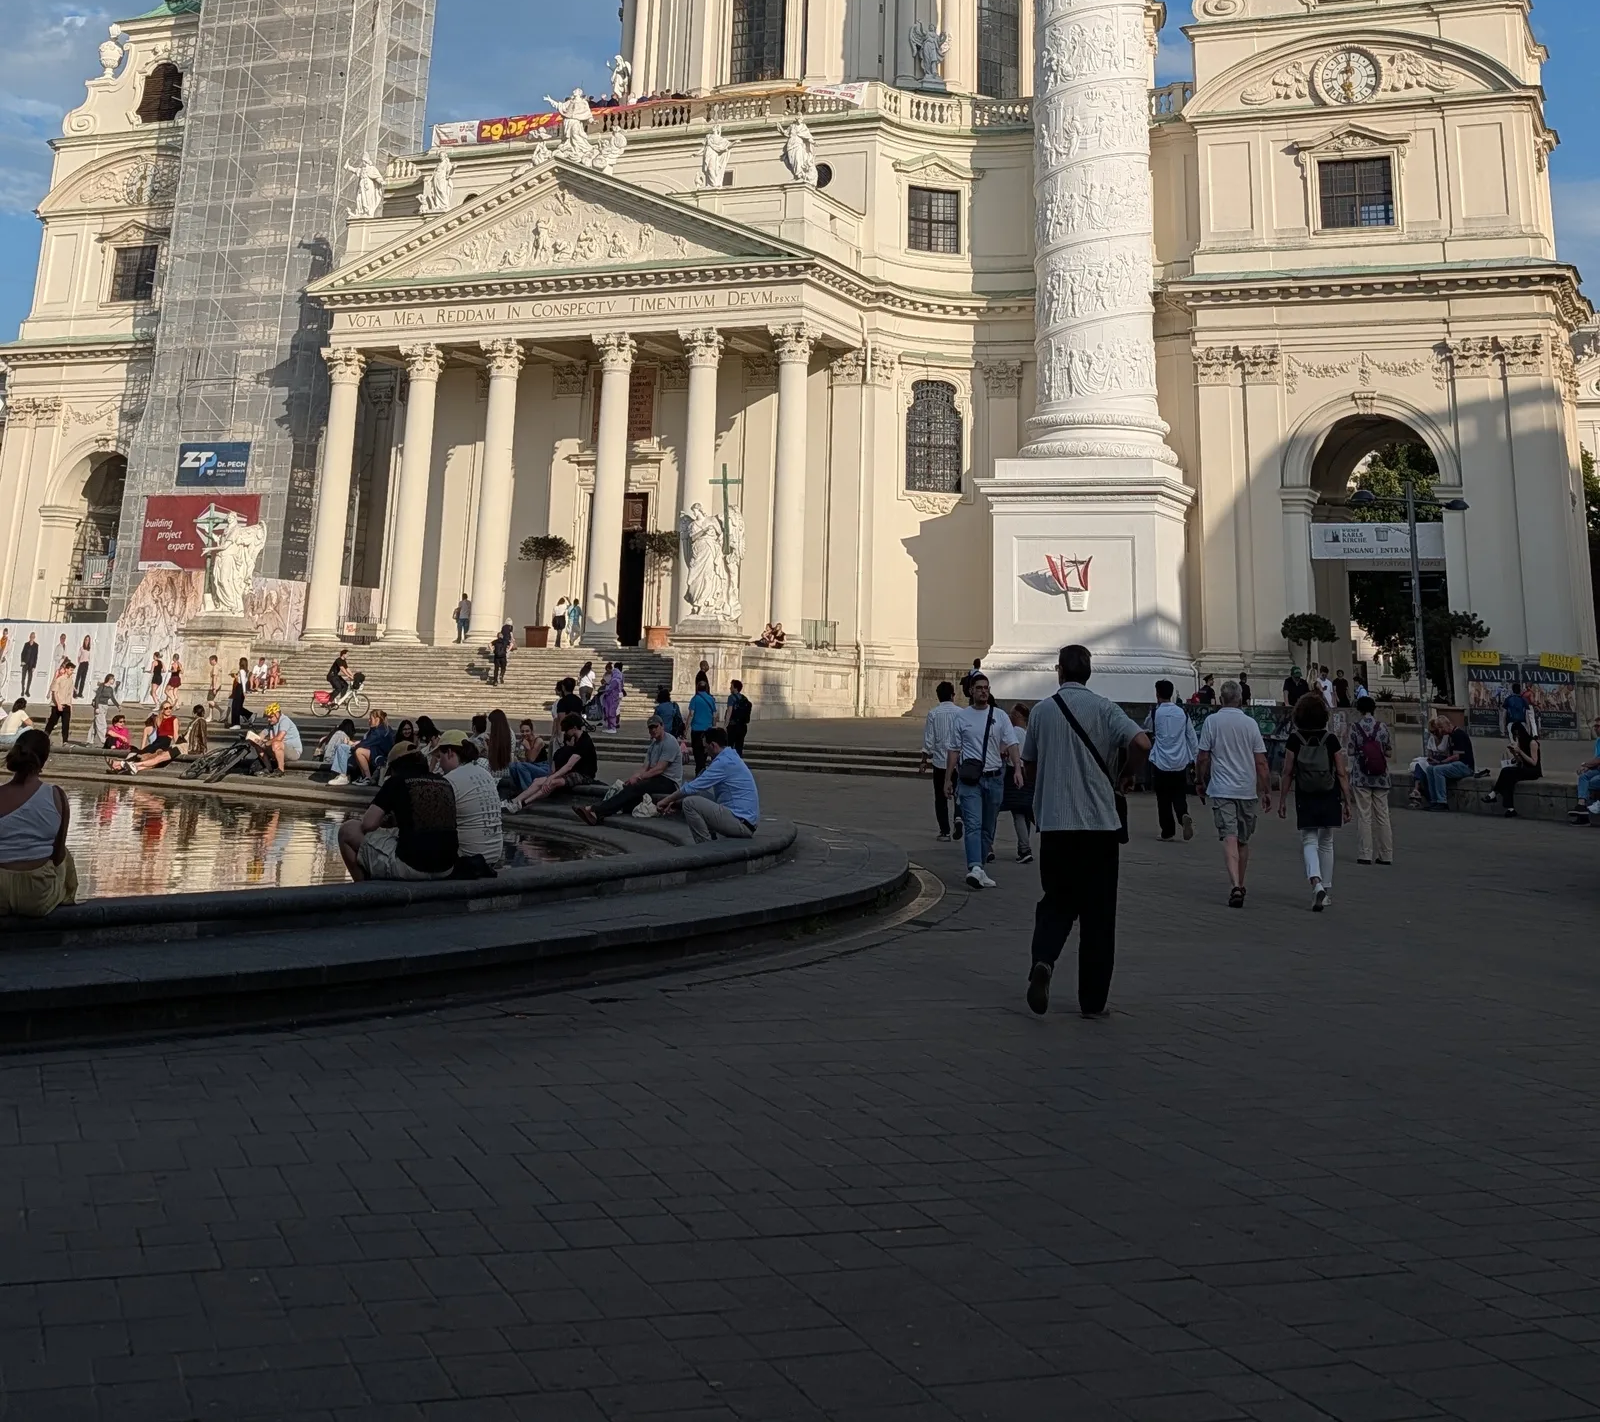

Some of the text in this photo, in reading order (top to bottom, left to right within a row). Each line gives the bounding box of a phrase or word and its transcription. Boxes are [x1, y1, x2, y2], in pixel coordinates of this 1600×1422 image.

[348, 313, 381, 328] VOTA
[393, 311, 425, 326] MEA
[436, 308, 496, 323] REDDAM
[507, 305, 521, 319] IN
[532, 301, 617, 317] CONSPECTV
[629, 295, 715, 311] TIMENTIVM
[145, 518, 173, 529] building
[157, 530, 183, 541] project
[167, 542, 195, 552] experts
[1462, 650, 1498, 659] TICKETS
[1548, 662, 1573, 670] TODAY
[1470, 669, 1516, 681] VIVALDI
[1525, 670, 1571, 683] VIVALDI
